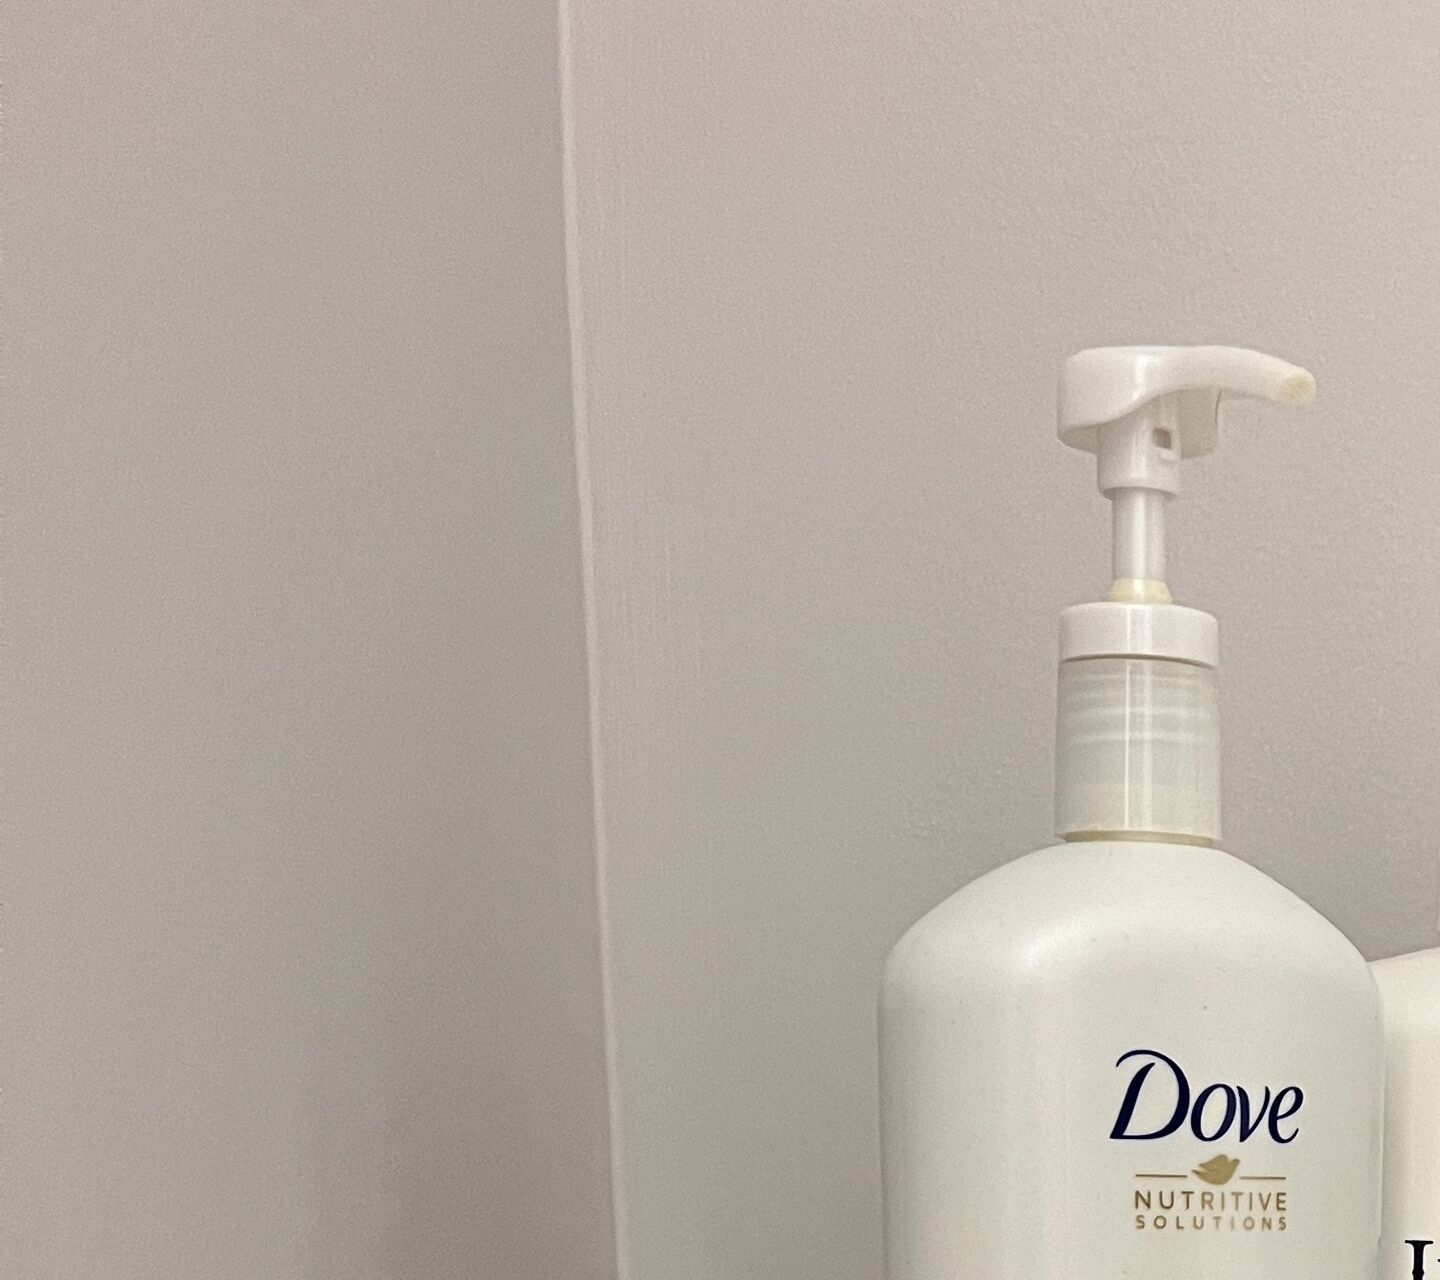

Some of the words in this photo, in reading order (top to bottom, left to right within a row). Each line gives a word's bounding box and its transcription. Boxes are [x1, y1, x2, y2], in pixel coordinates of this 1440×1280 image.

[1109, 1049, 1303, 1143] Dove
[1135, 1190, 1287, 1211] NUTRITIVE
[1135, 1214, 1287, 1230] SOLUTIONS
